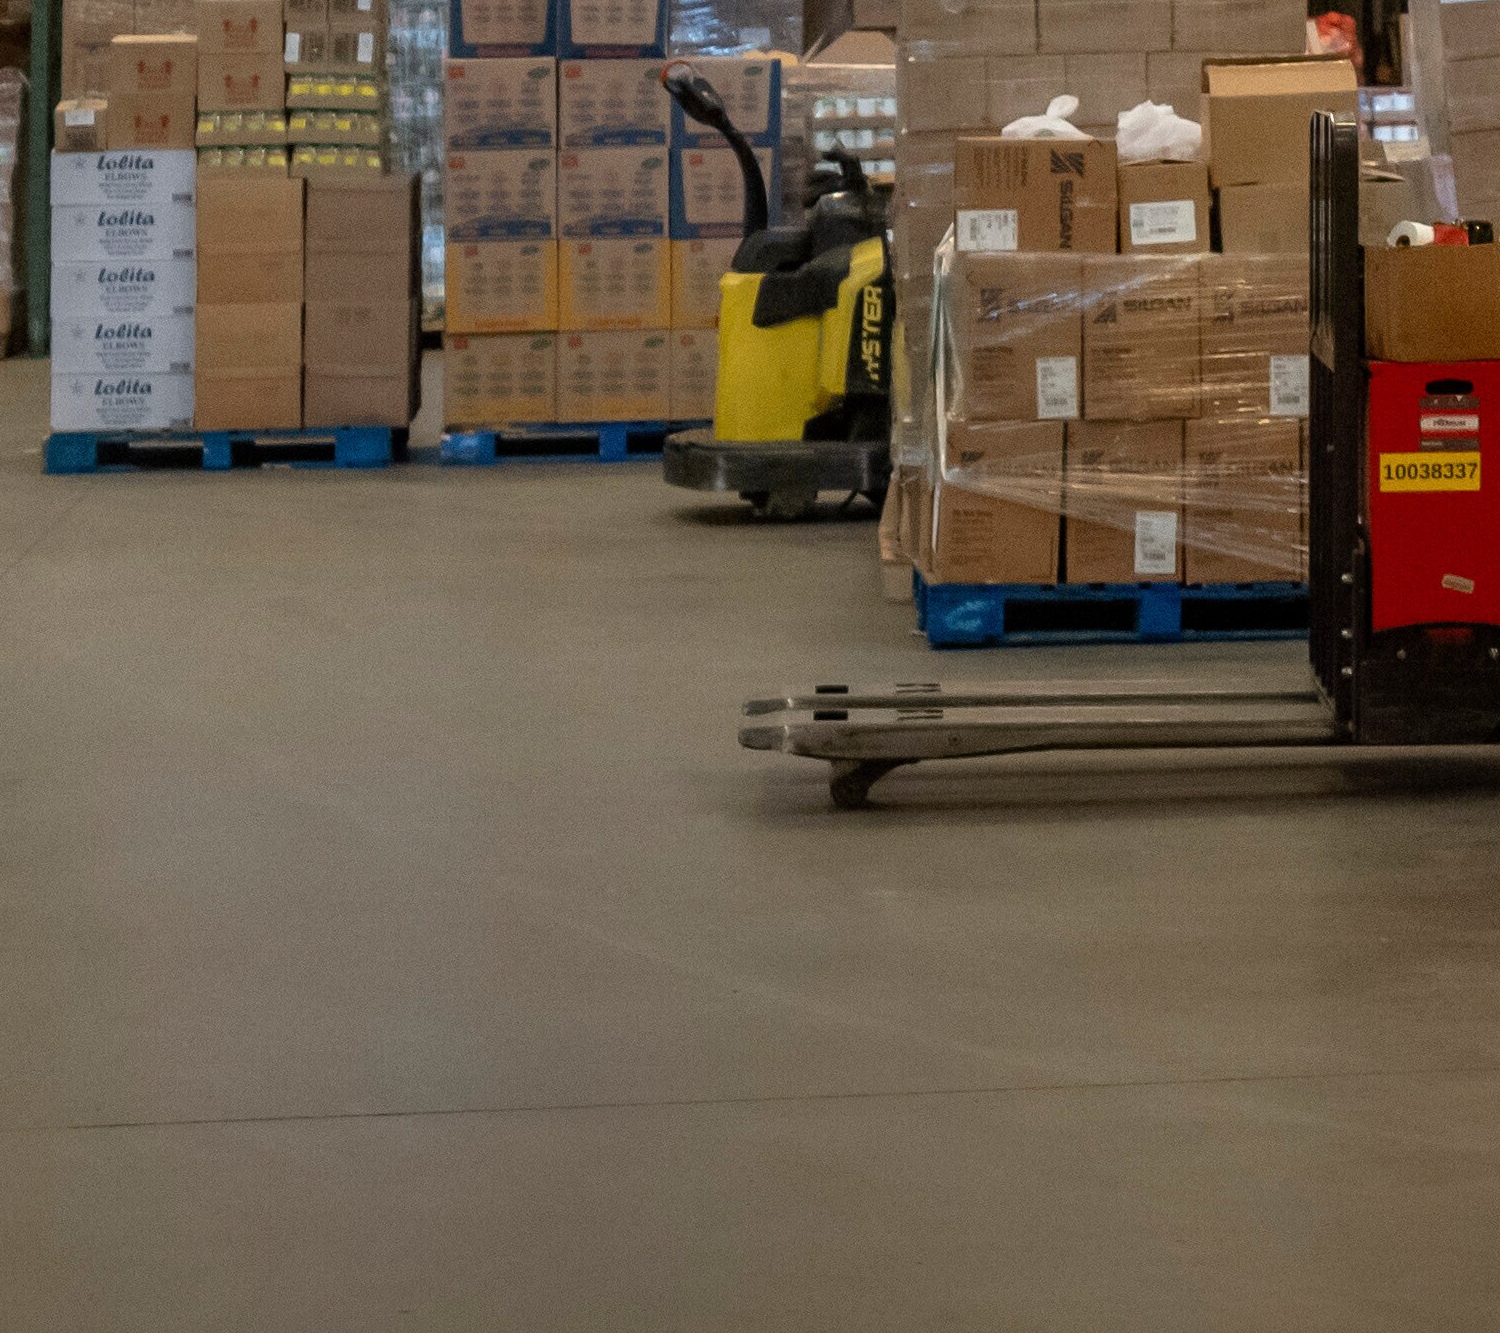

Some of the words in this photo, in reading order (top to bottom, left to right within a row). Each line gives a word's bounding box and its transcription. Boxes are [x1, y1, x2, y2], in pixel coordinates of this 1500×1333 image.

[97, 154, 155, 171] Lolita
[97, 210, 155, 227] Lolita
[98, 267, 156, 284] Lolita
[95, 323, 153, 339] Lolita
[861, 283, 883, 381] YSTER
[94, 378, 153, 396] Lolita
[1383, 461, 1479, 481] 10038337
